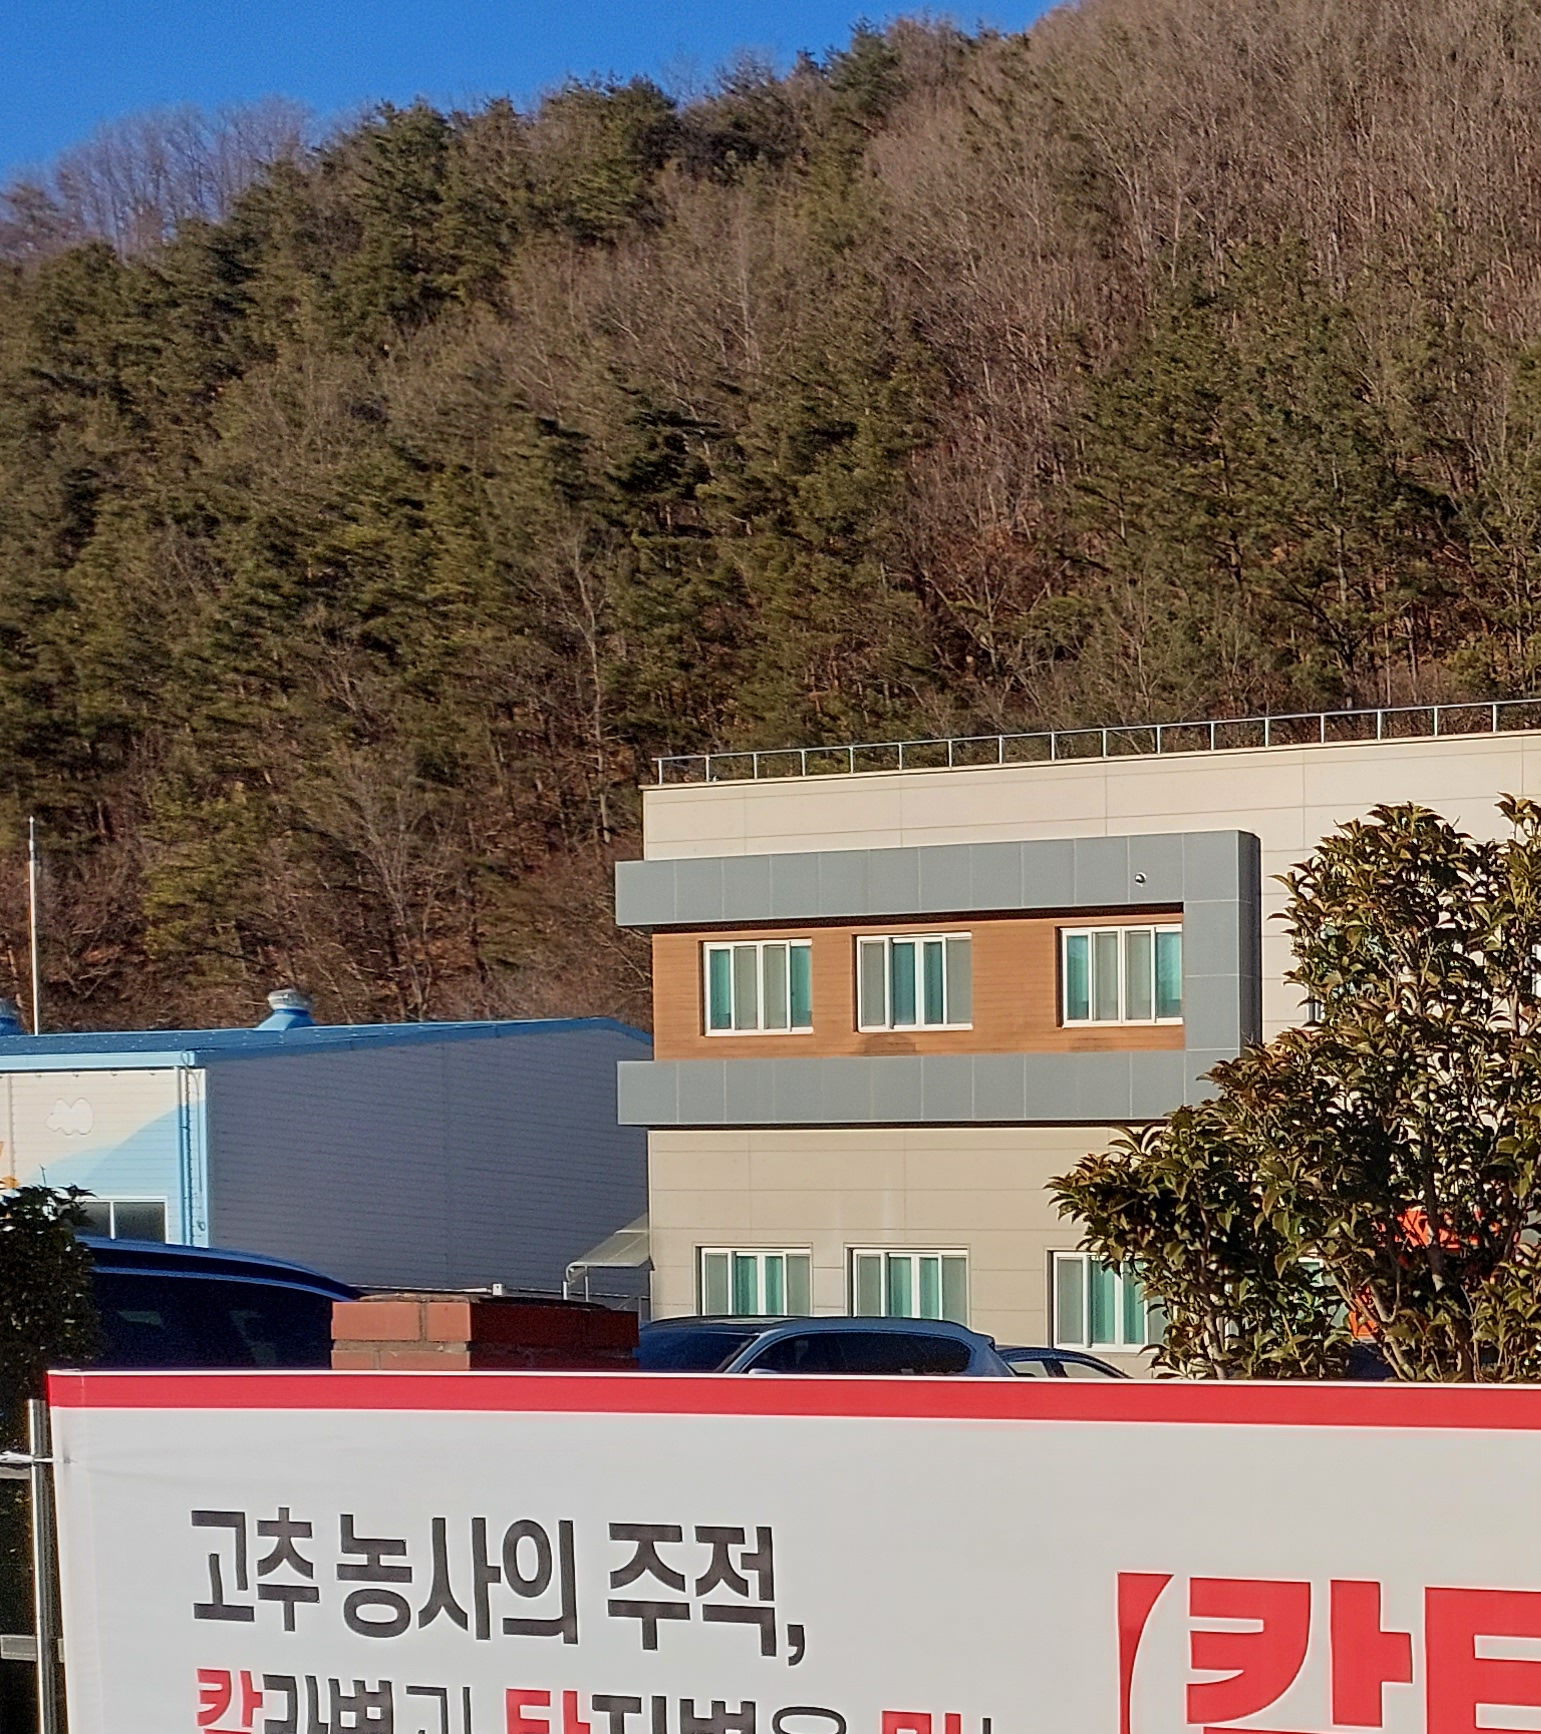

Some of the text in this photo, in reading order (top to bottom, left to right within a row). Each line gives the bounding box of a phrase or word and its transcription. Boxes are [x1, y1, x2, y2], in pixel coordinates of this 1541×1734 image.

[191, 1507, 807, 1667] 고추 농사의 주적,
